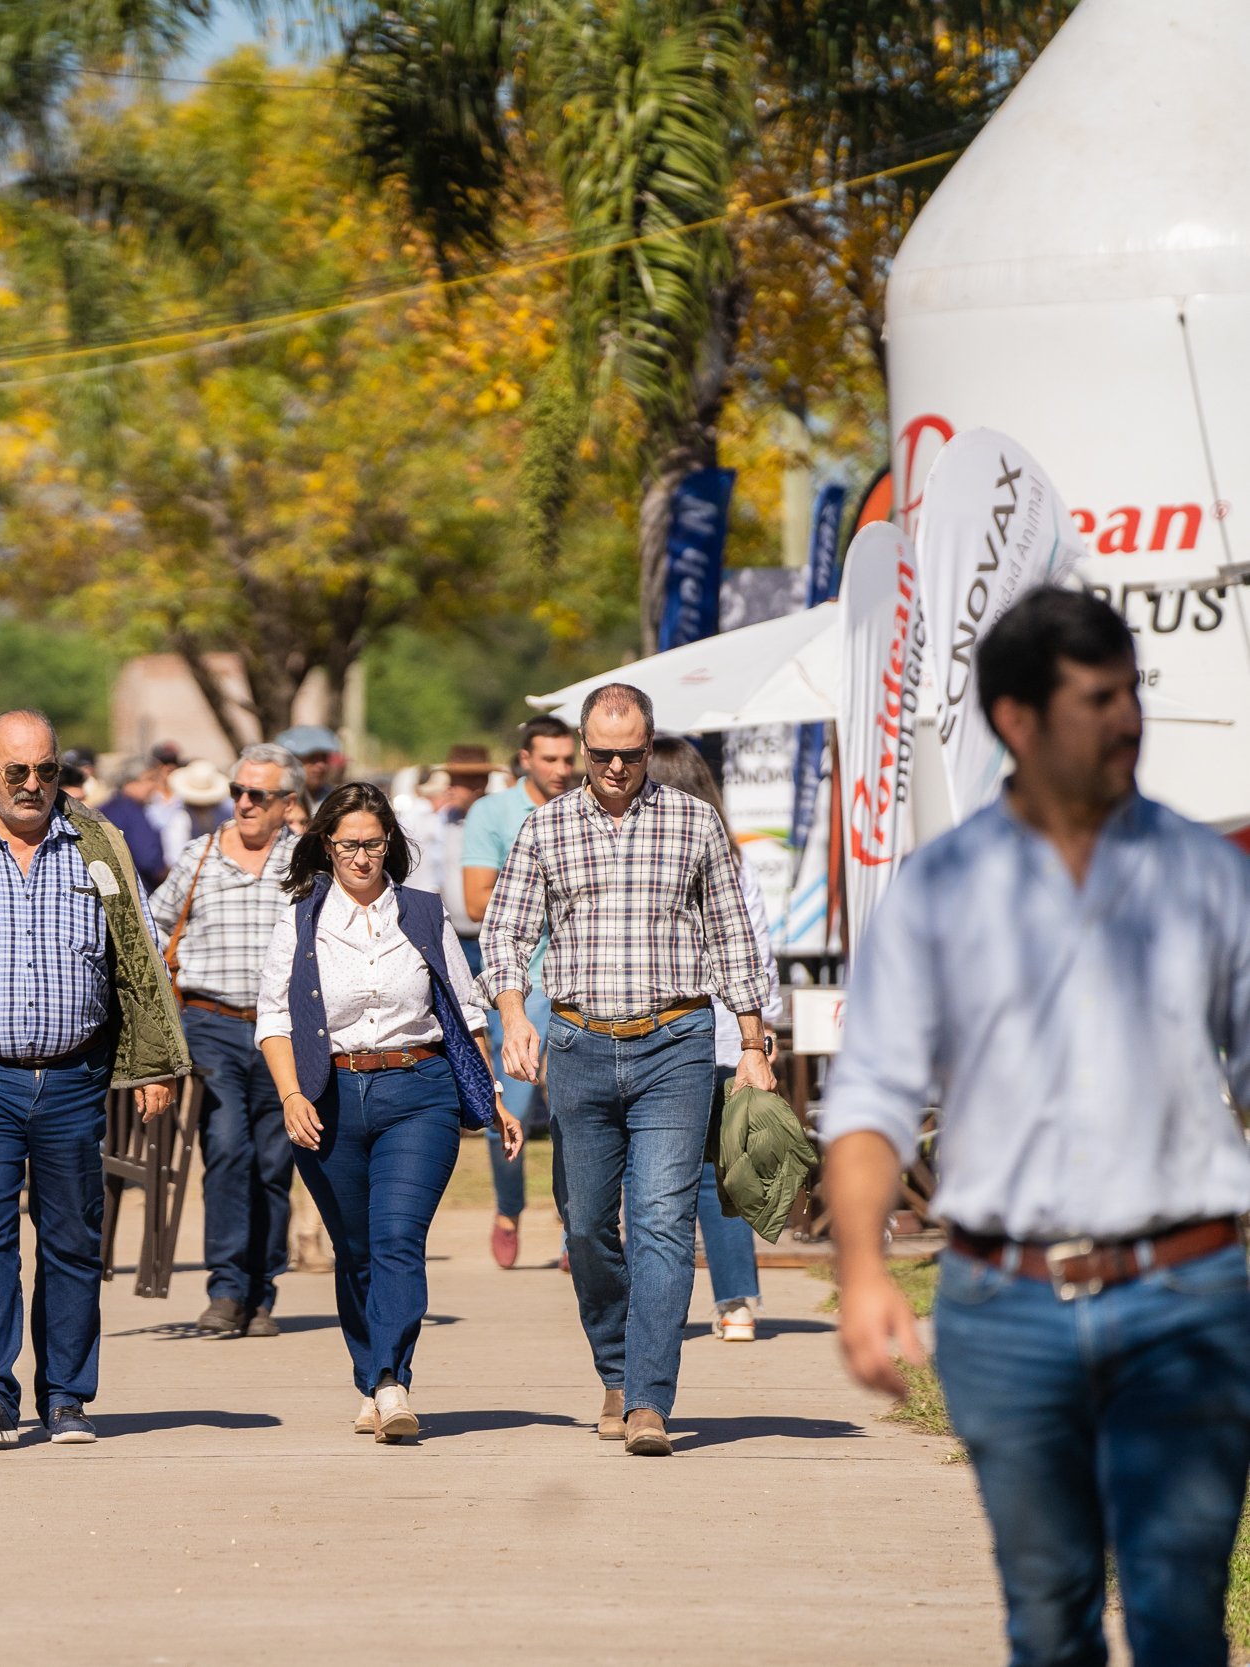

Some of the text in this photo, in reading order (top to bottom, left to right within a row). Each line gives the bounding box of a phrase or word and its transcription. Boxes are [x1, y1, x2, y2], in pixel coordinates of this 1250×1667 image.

[937, 452, 1022, 745] ECNOVAX
[988, 474, 1045, 632] nidad Animal
